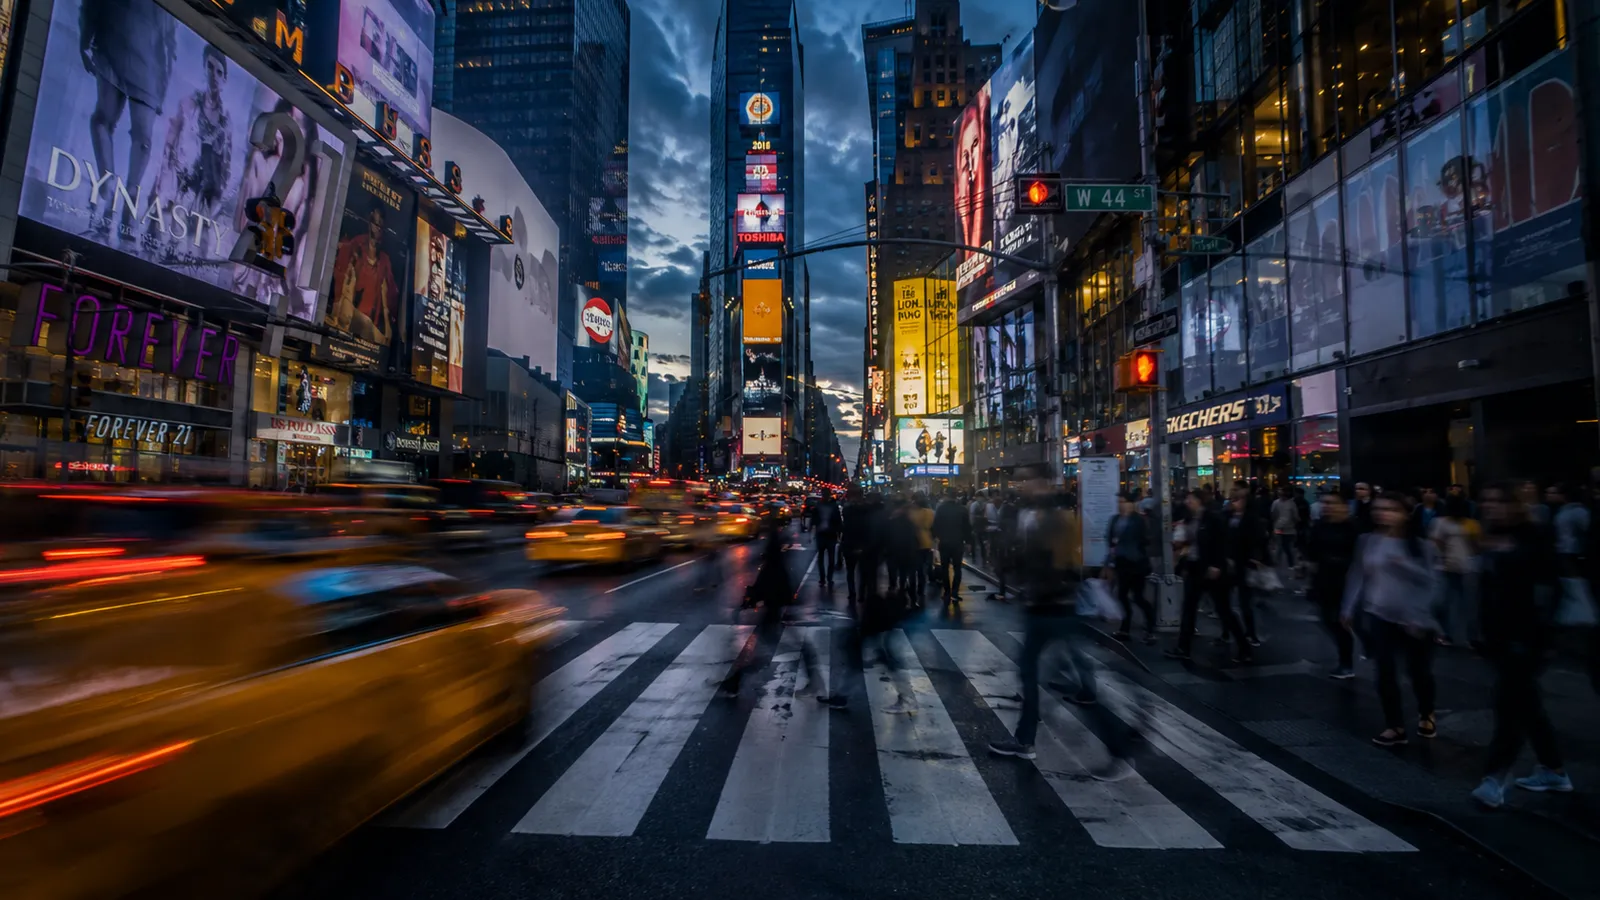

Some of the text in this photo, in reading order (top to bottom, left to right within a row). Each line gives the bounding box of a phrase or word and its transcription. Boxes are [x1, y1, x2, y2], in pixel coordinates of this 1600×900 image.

[47, 146, 230, 257] DYNASTY
[1077, 188, 1145, 207] W 44 ST
[738, 233, 784, 242] TOSHIBA
[31, 282, 239, 385] FOREVER
[85, 414, 192, 445] FOREVER 21
[288, 419, 313, 432] POLO
[1166, 399, 1247, 434] SKECHERS
